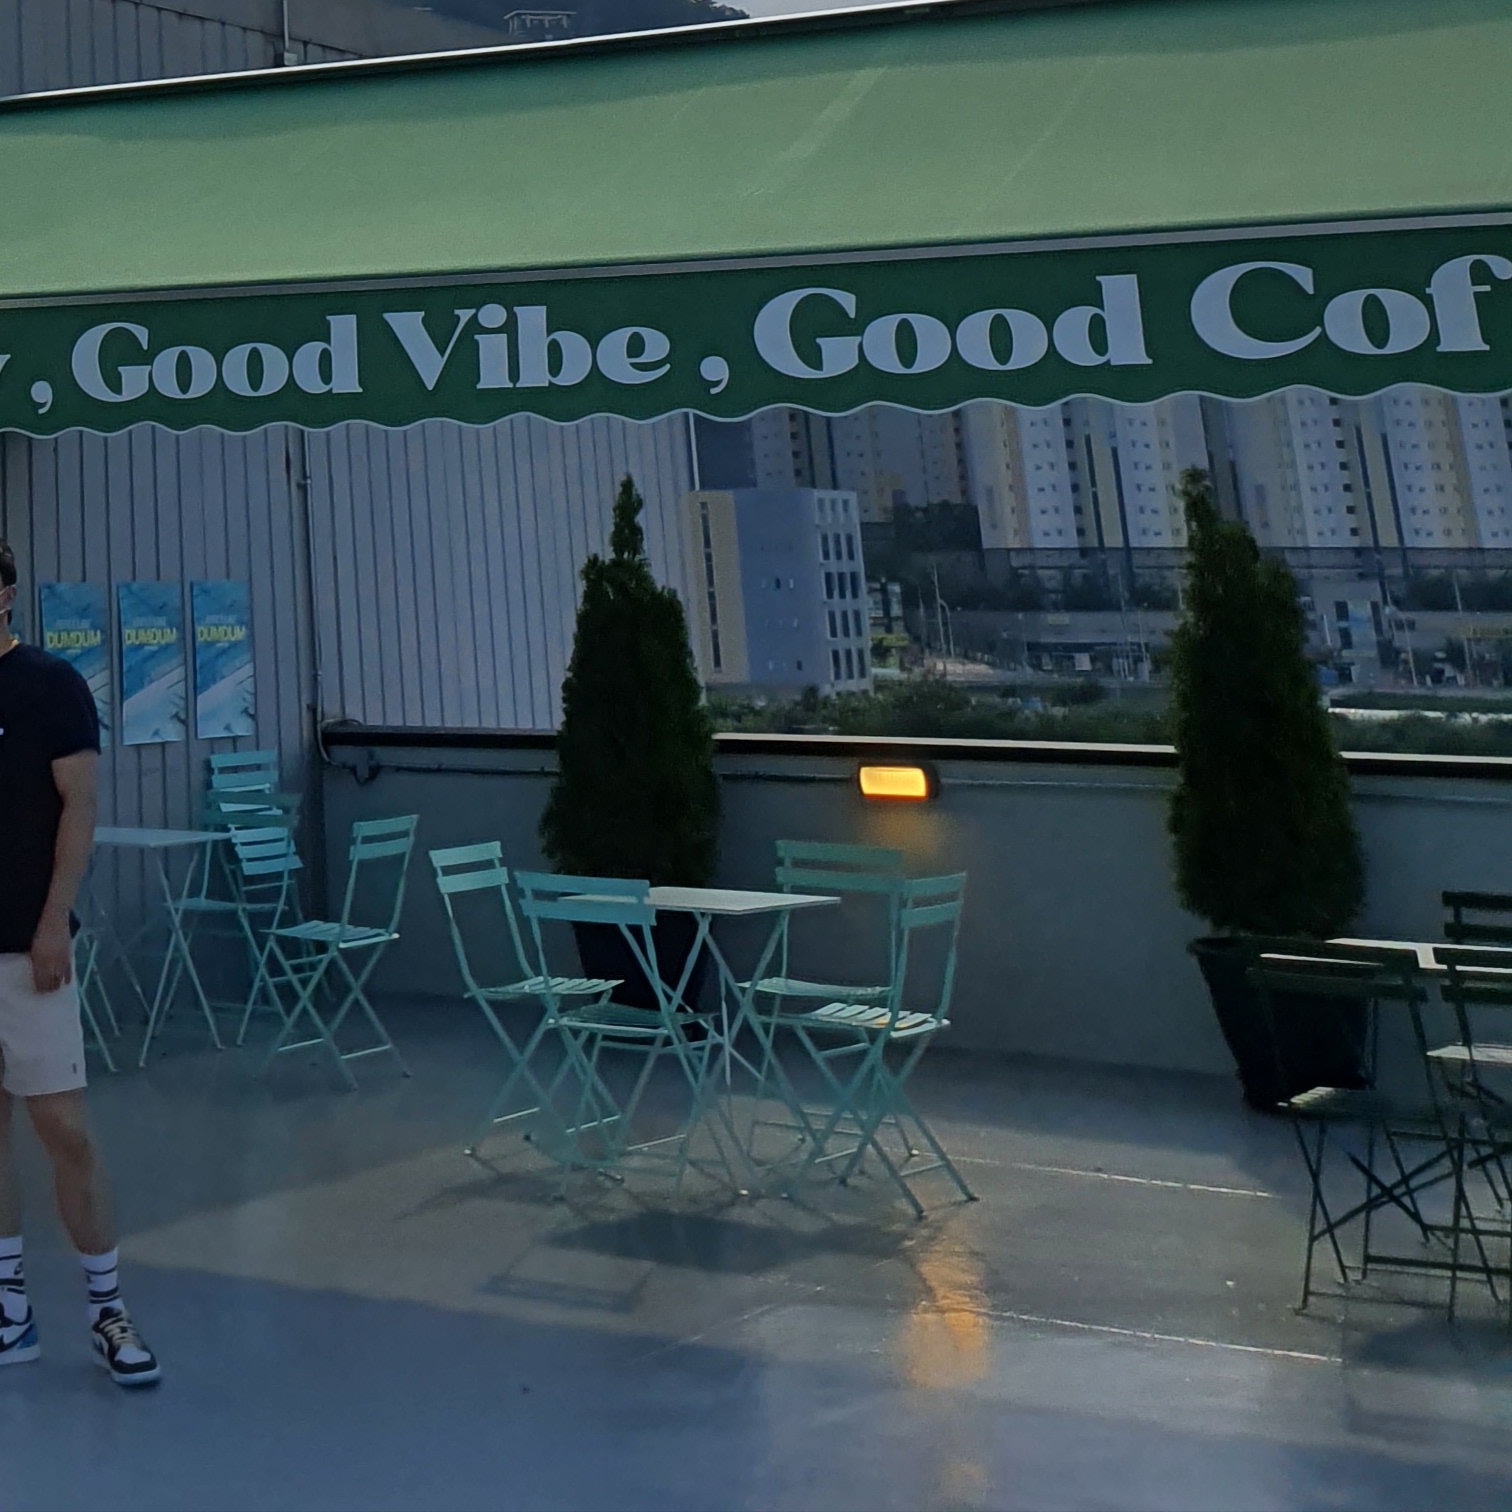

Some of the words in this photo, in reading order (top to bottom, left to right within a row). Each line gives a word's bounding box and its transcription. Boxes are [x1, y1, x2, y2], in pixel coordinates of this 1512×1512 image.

[70, 312, 364, 403] Good
[753, 273, 1154, 380] Good
[46, 628, 102, 649] DUMDUM
[124, 626, 177, 646] DUMDUM
[197, 624, 247, 642] DUMDUM
